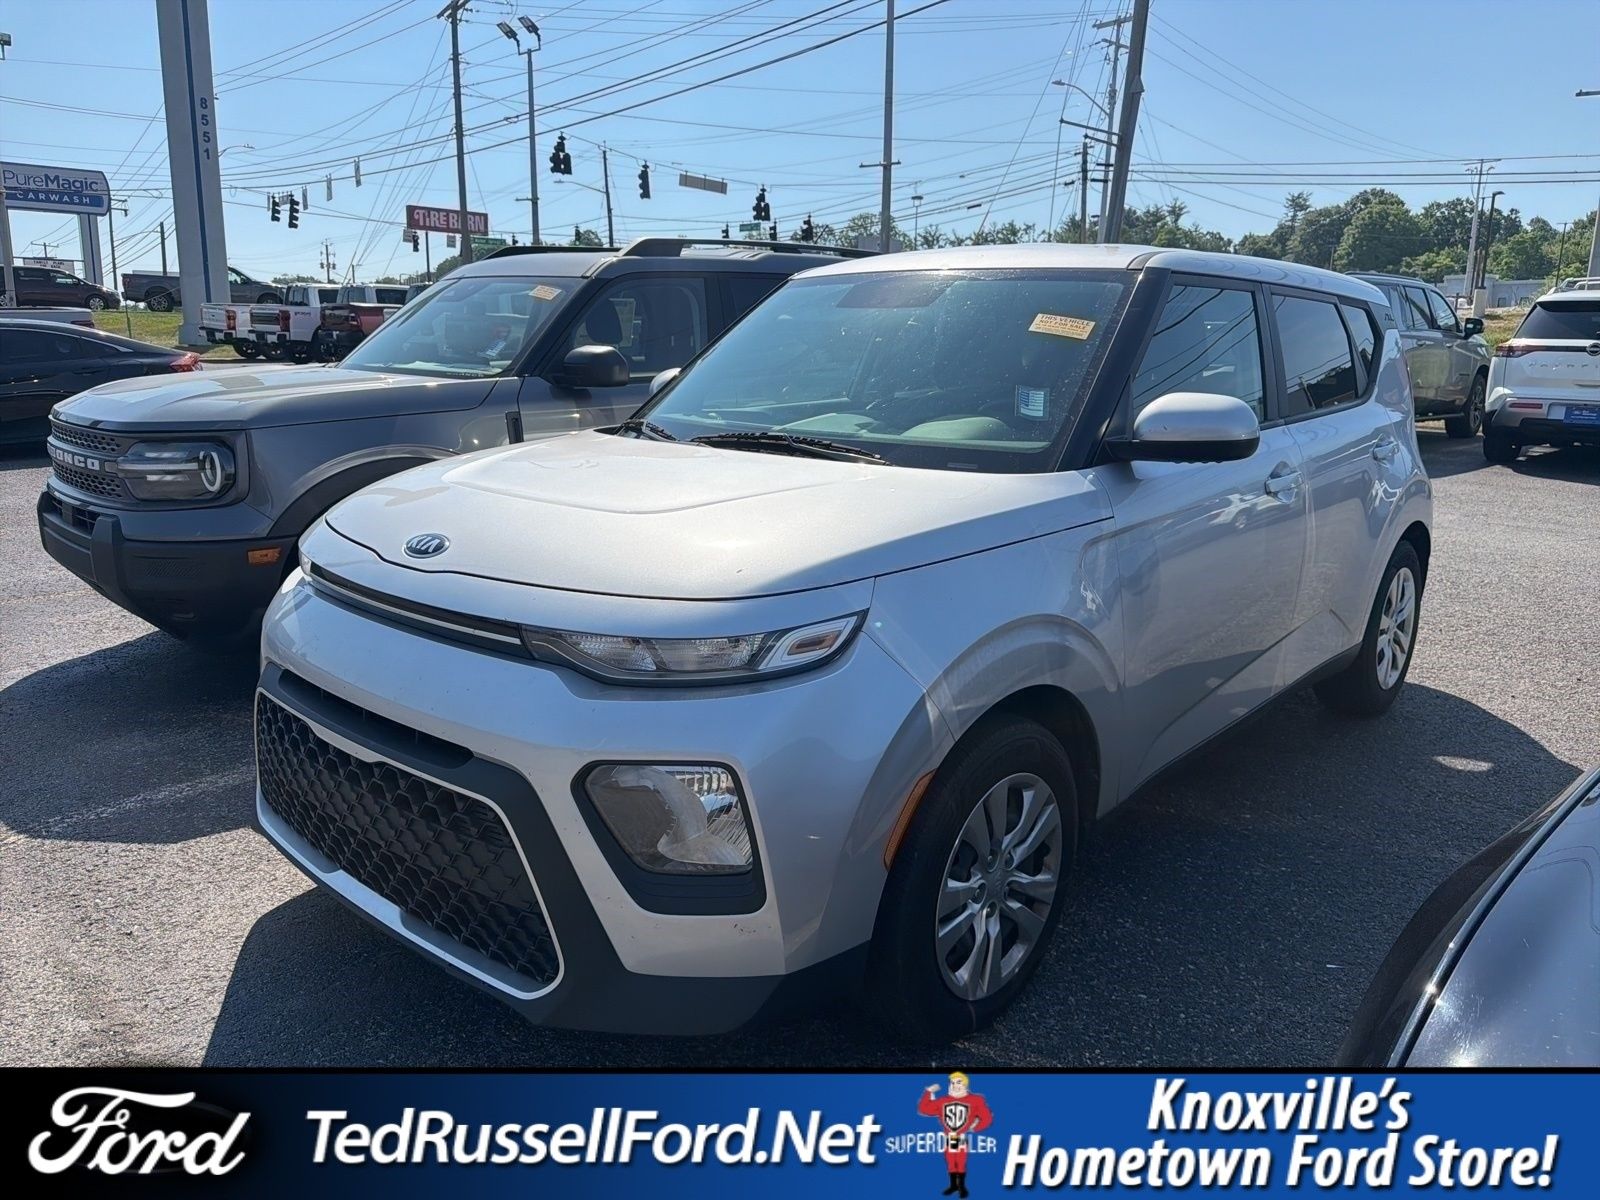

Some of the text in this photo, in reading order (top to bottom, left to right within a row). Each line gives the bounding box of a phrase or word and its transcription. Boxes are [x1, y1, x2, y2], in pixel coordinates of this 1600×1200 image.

[200, 97, 211, 160] 8551
[3, 169, 99, 193] PureMagic
[17, 192, 90, 204] CARWASH
[1060, 318, 1091, 326] VEHICLE
[407, 535, 441, 553] KIA
